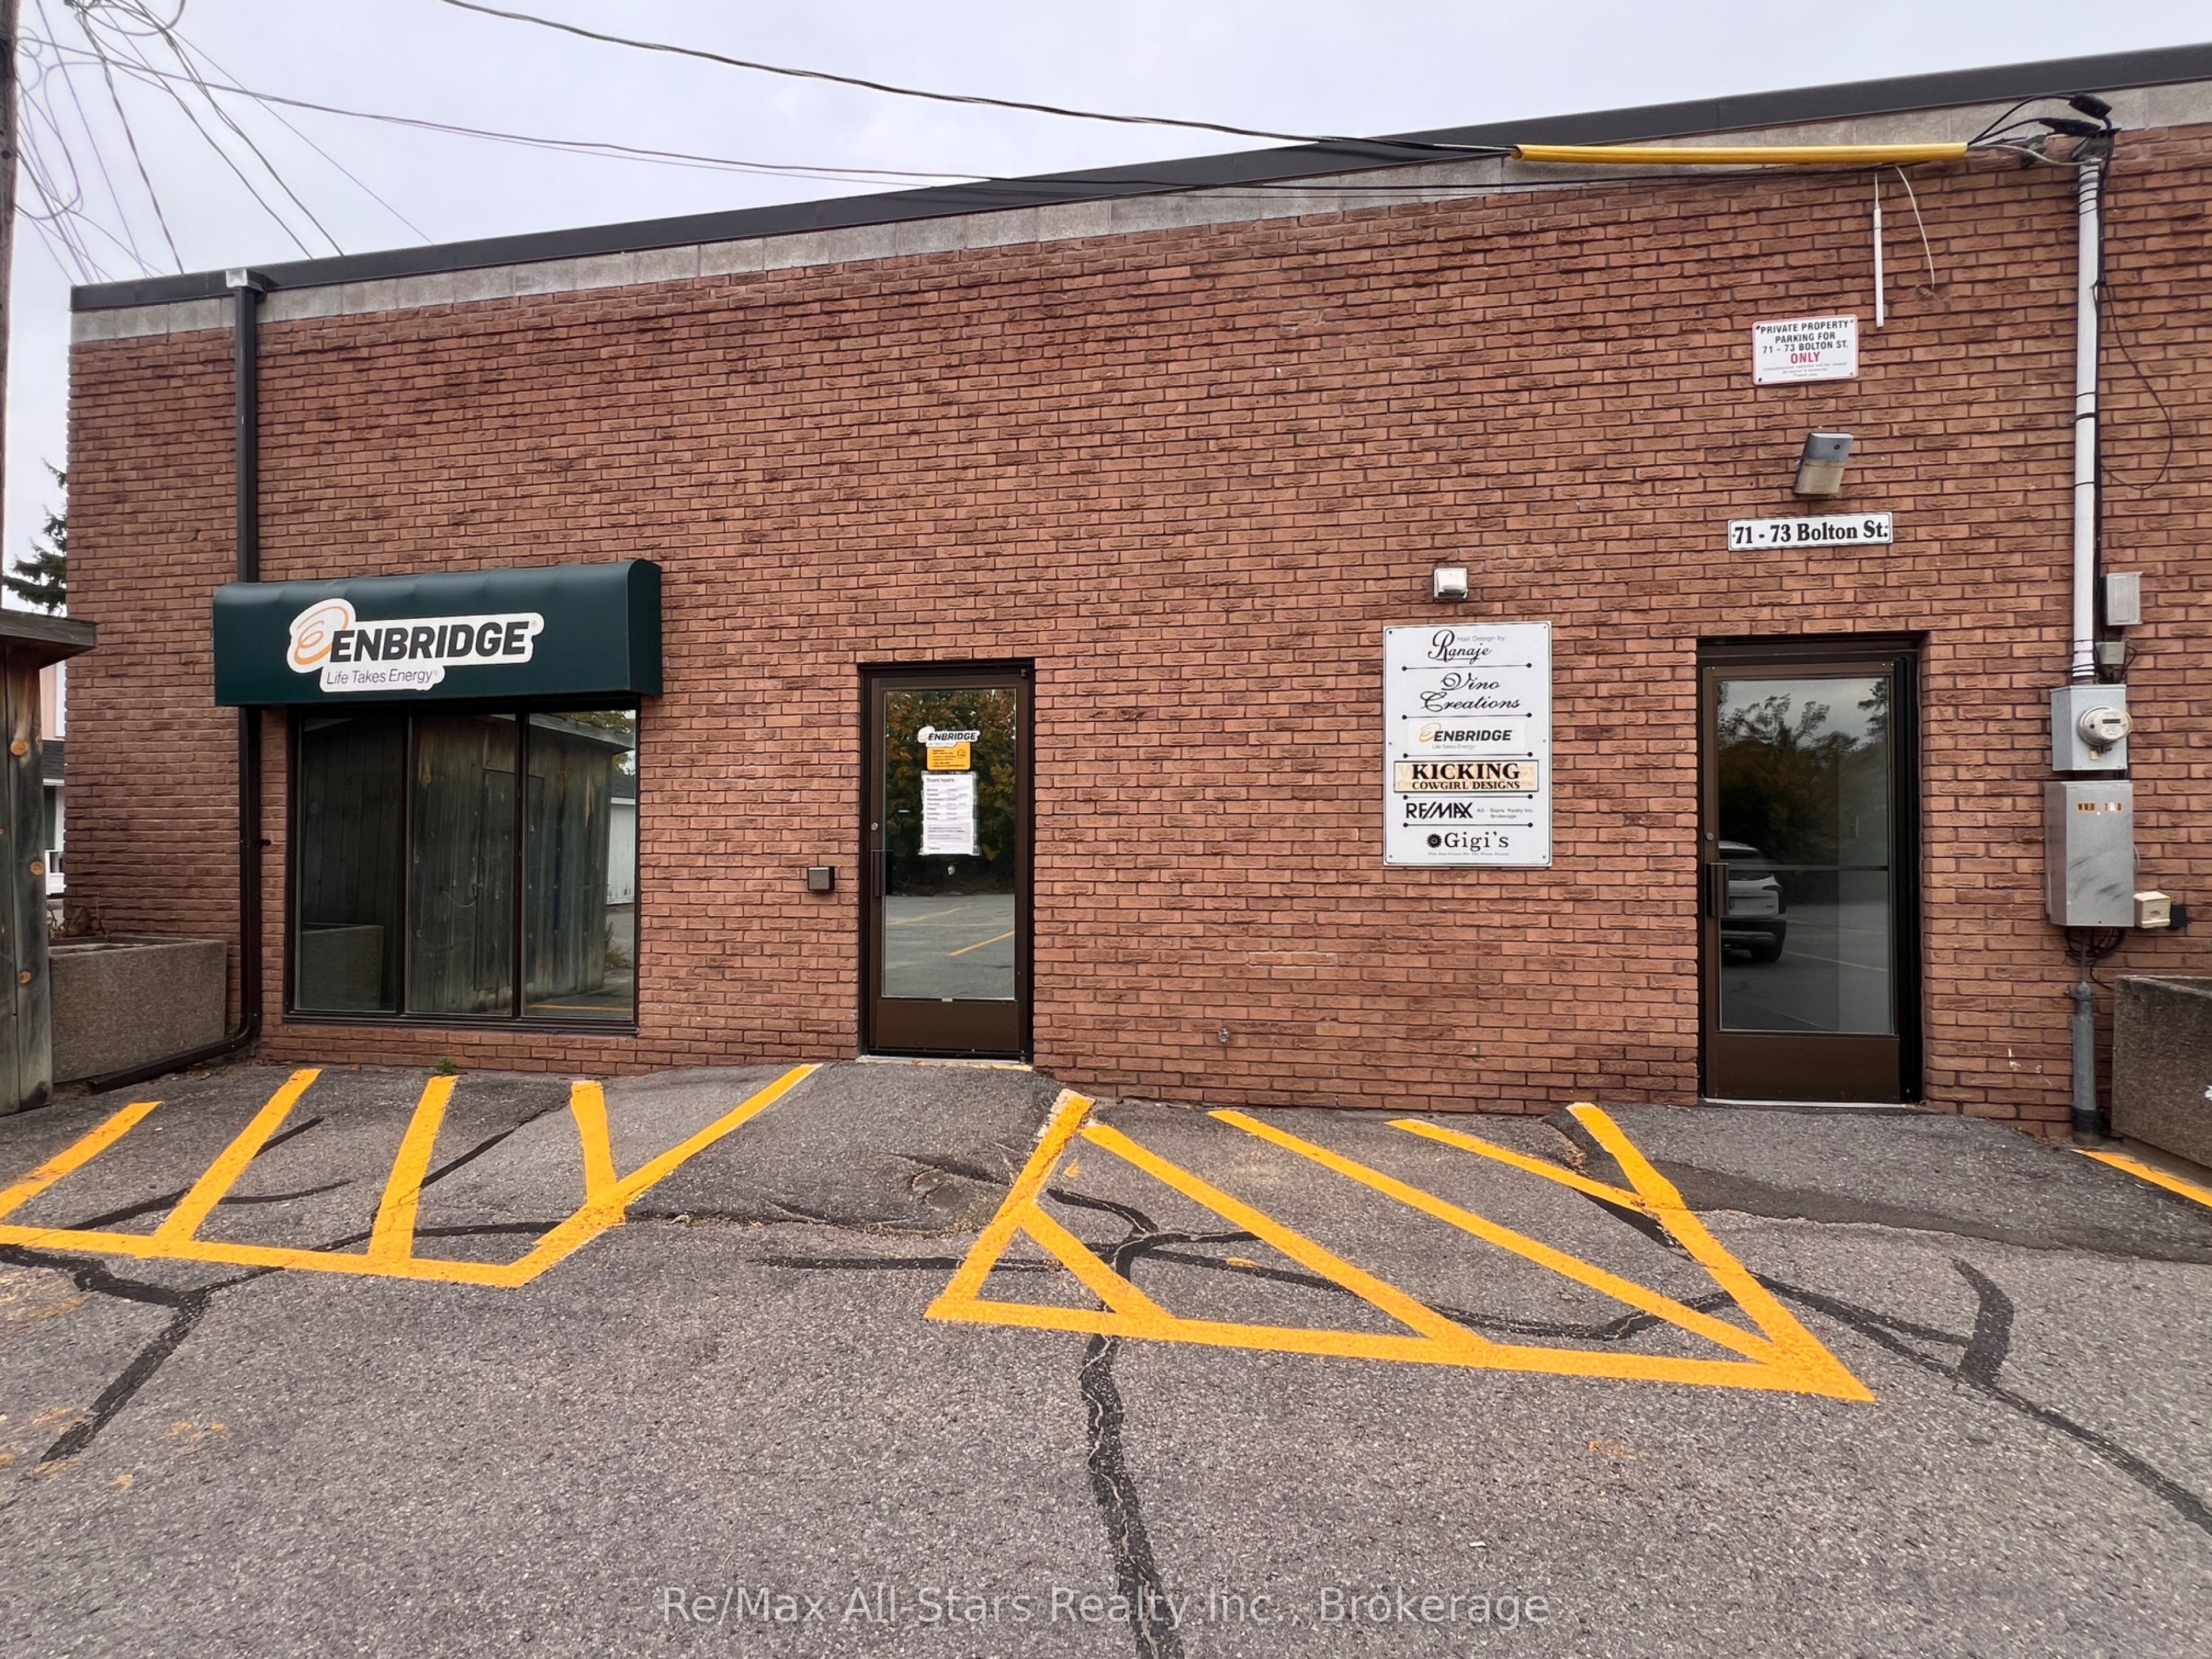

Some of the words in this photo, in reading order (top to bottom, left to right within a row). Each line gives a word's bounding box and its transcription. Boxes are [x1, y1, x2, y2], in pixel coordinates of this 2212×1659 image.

[1760, 324, 1798, 334] PRIVATE
[1801, 320, 1849, 331] PROPERTY
[1775, 334, 1814, 344] PARKING
[1818, 332, 1835, 340] FOR
[1763, 346, 1773, 354] 71
[1785, 344, 1795, 352] 73
[1799, 341, 1833, 351] BOLTON
[1836, 340, 1849, 349] ST.
[1790, 352, 1820, 363] ONLY
[1734, 527, 1752, 544] 71
[1770, 524, 1791, 542] 73
[1797, 521, 1858, 541] Bolton
[1863, 520, 1888, 538] St.
[329, 621, 529, 662] ENBRIDGE
[1427, 629, 1493, 665] Ranaje
[327, 670, 349, 684] Life
[352, 670, 386, 683] Takes
[389, 669, 433, 684] Energy
[1440, 672, 1501, 691] Vino
[1419, 691, 1521, 712] Creations
[928, 732, 977, 741] ENBRIDGE
[1434, 729, 1513, 742] ENBRIDGE
[1411, 763, 1520, 780] KICKING
[1411, 781, 1468, 790] COWGIRL
[1472, 781, 1520, 789] DESIGNS
[1406, 801, 1473, 819] RE/MAX
[1444, 831, 1509, 852] Gigi's
